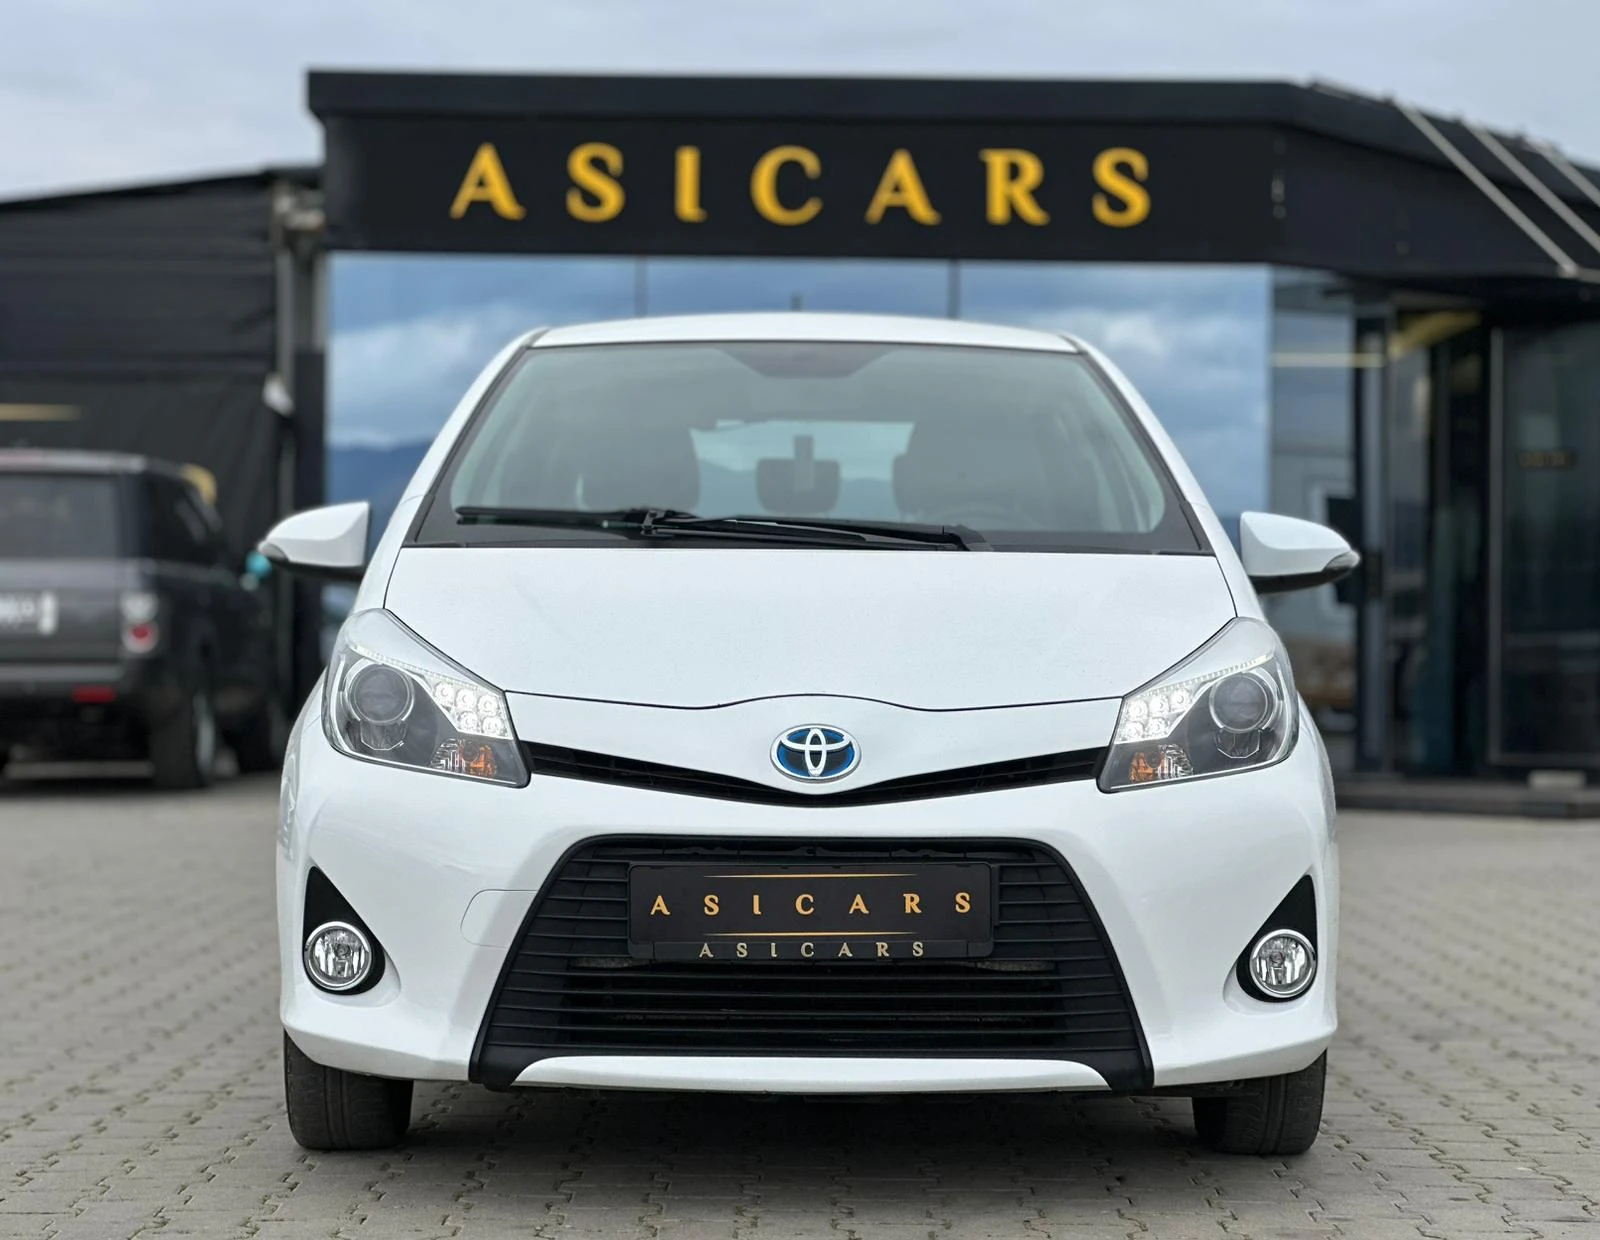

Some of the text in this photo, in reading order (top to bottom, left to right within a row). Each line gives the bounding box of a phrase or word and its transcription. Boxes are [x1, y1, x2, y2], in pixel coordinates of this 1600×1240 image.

[450, 142, 1151, 227] ASICARS
[650, 892, 971, 915] ASICARS
[699, 942, 925, 958] ASICARS
